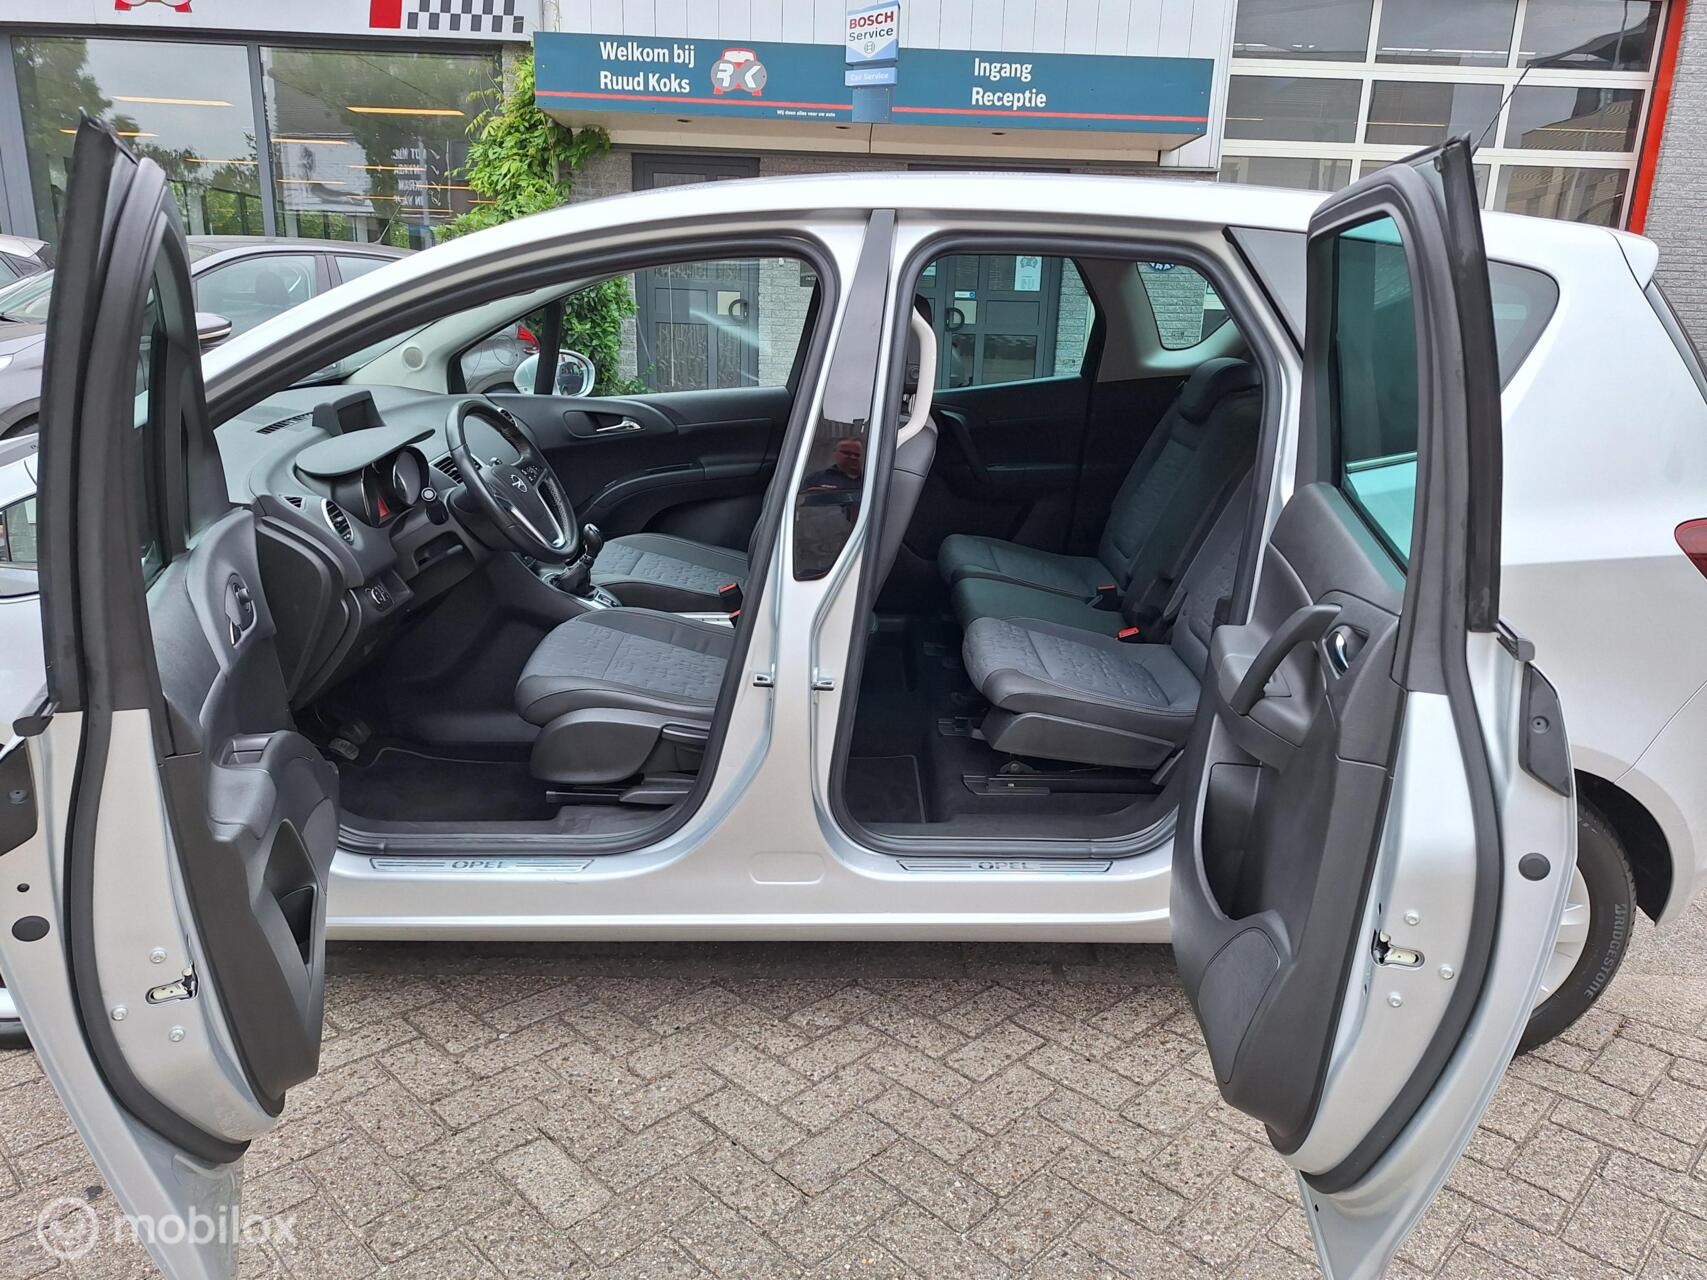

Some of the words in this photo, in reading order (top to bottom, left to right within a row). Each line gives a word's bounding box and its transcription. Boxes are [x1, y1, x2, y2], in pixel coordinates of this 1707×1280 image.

[849, 10, 894, 29] BOSCH
[848, 27, 894, 42] Service
[599, 41, 669, 63] Welkom
[673, 43, 696, 69] bij
[863, 71, 889, 81] Service
[974, 57, 1033, 82] Ingang
[599, 70, 644, 91] Ruud
[648, 72, 691, 94] Koks
[971, 86, 1047, 111] Receptie
[452, 860, 504, 869] OPEL
[978, 861, 1032, 870] OPEL
[1583, 902, 1628, 1001] BRIDGESTONE
